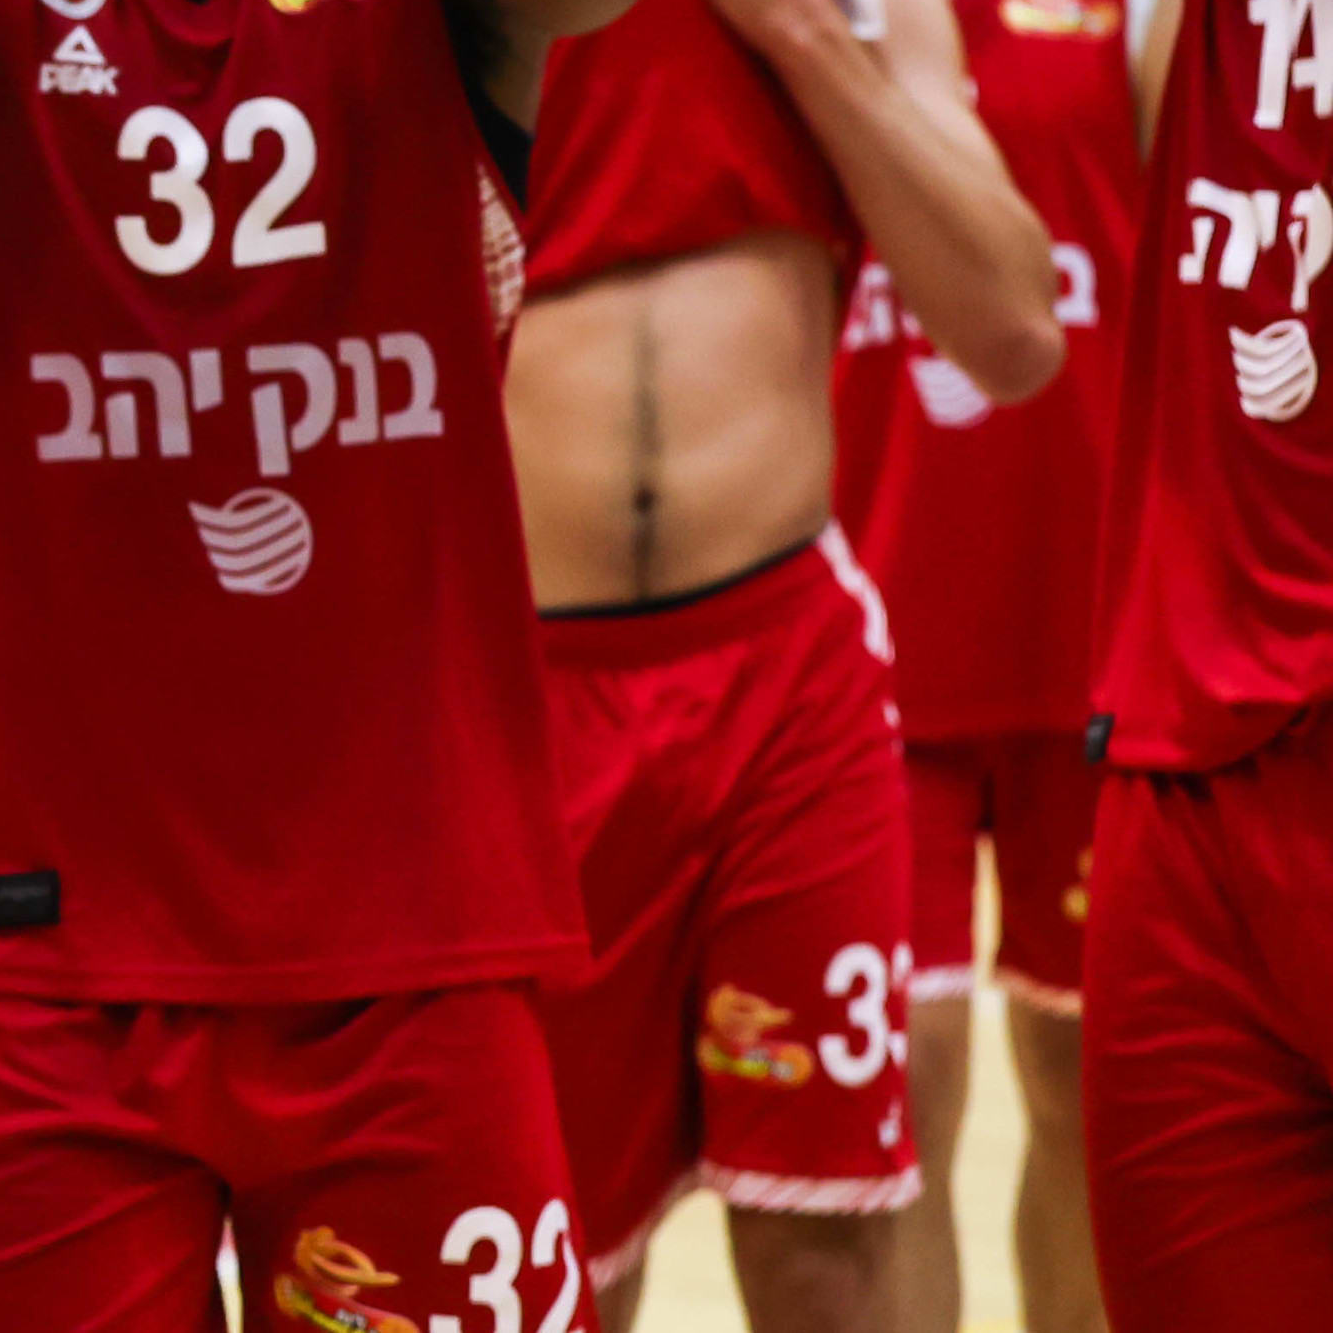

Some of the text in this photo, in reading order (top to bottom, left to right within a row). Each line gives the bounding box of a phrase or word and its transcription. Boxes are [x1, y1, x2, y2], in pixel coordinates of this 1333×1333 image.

[116, 96, 326, 276] 32
[31, 333, 443, 477] בנק יהב
[428, 1198, 583, 1333] 32
